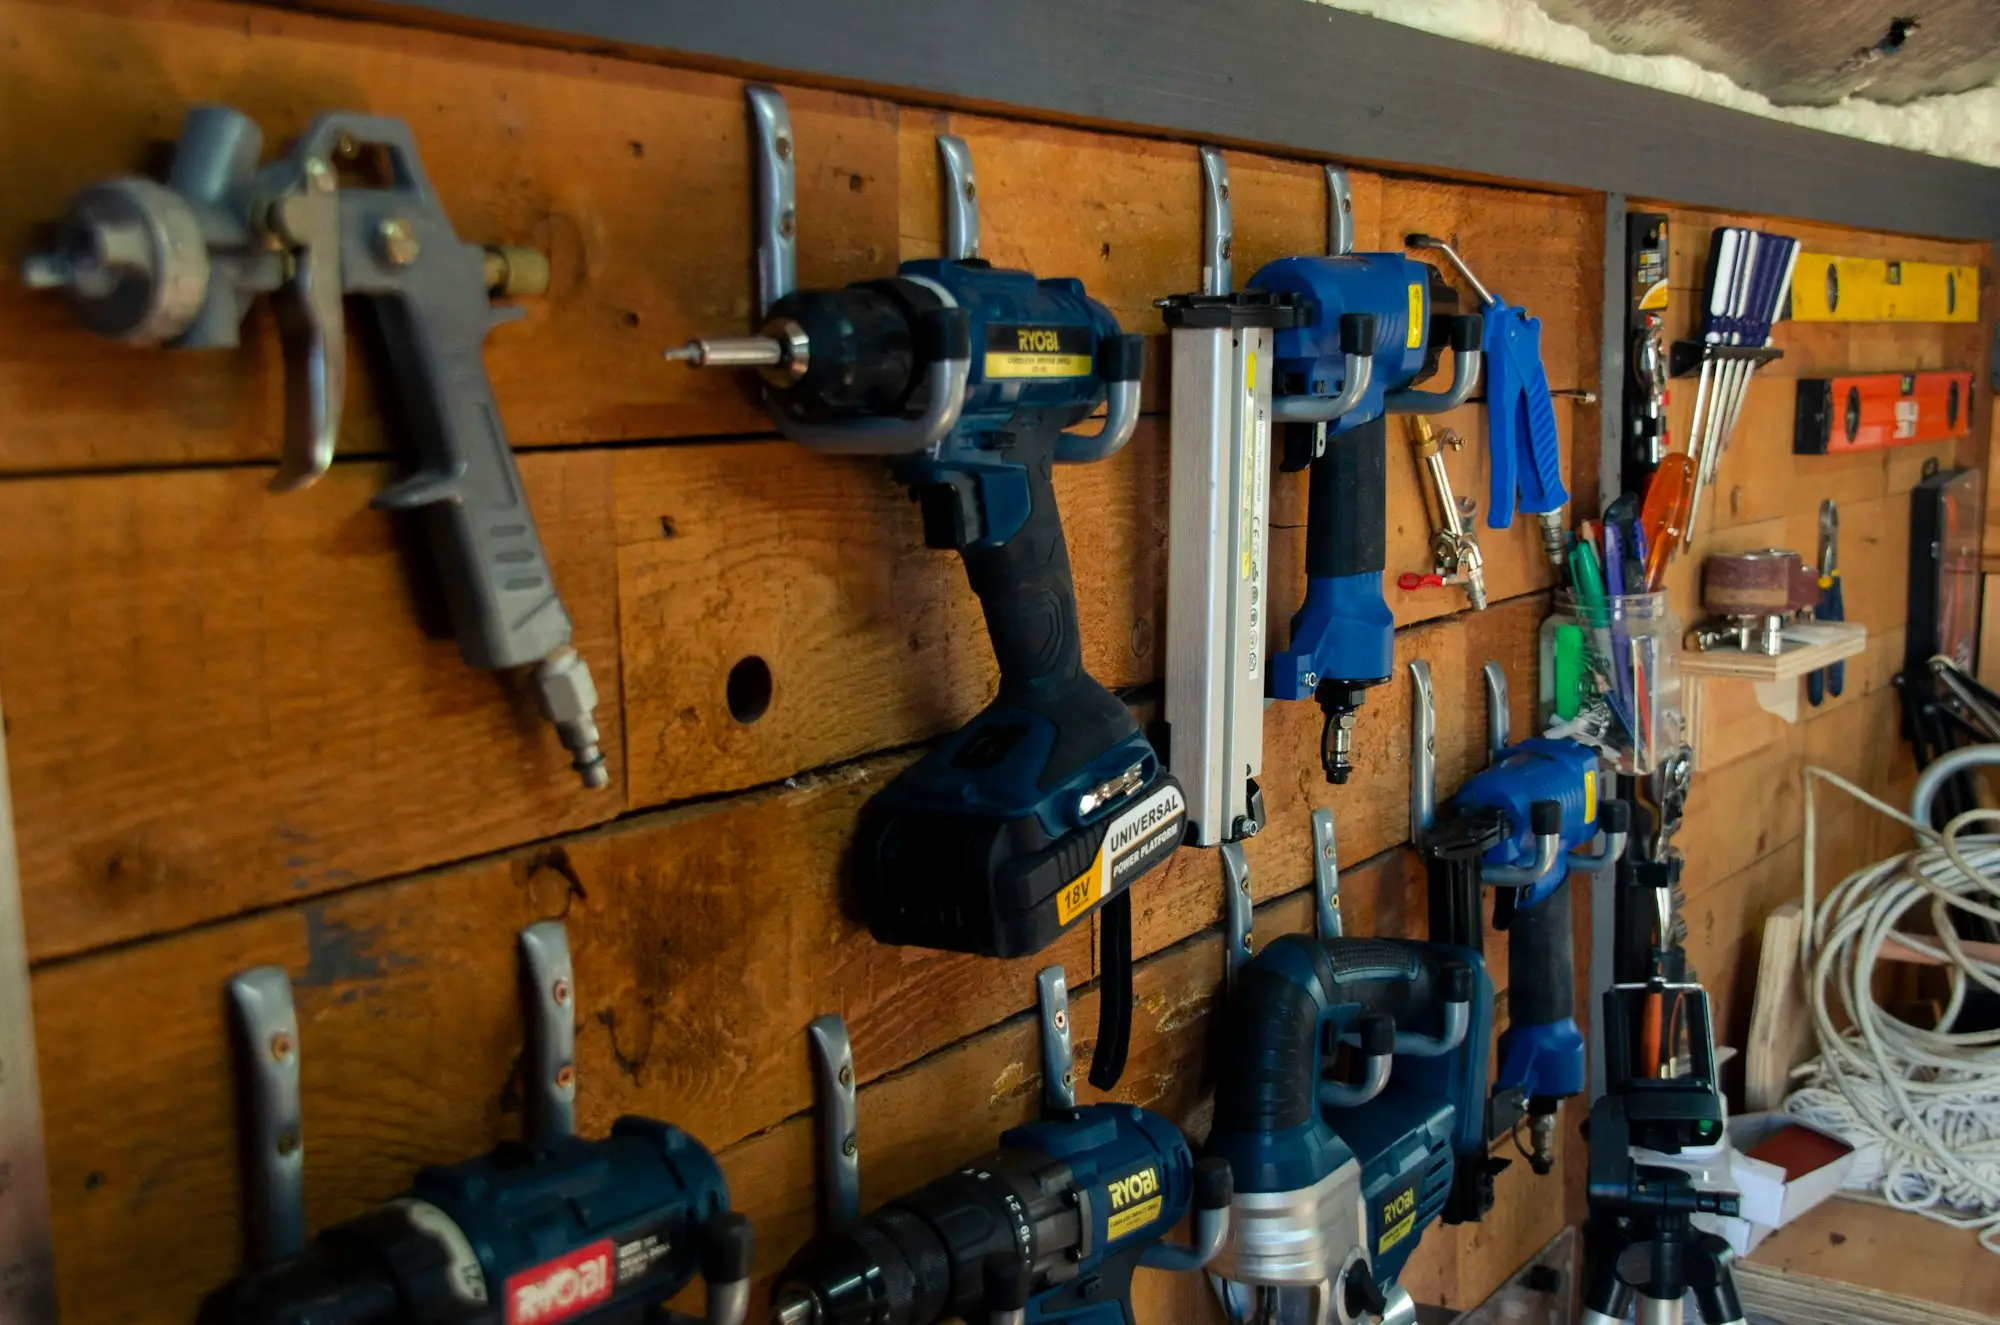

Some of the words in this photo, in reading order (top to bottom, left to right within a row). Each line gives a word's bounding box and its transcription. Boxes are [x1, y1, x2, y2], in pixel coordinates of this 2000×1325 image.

[1016, 329, 1060, 352] RYOBI
[1110, 794, 1179, 852] UNIVERSAL
[1113, 850, 1140, 878] POWER
[1140, 823, 1178, 858] PLATFORM
[1064, 876, 1091, 909] 18V
[1107, 1167, 1159, 1209] RYOBI
[1383, 1186, 1414, 1225] RYOBI
[515, 1254, 608, 1324] RYOBI
